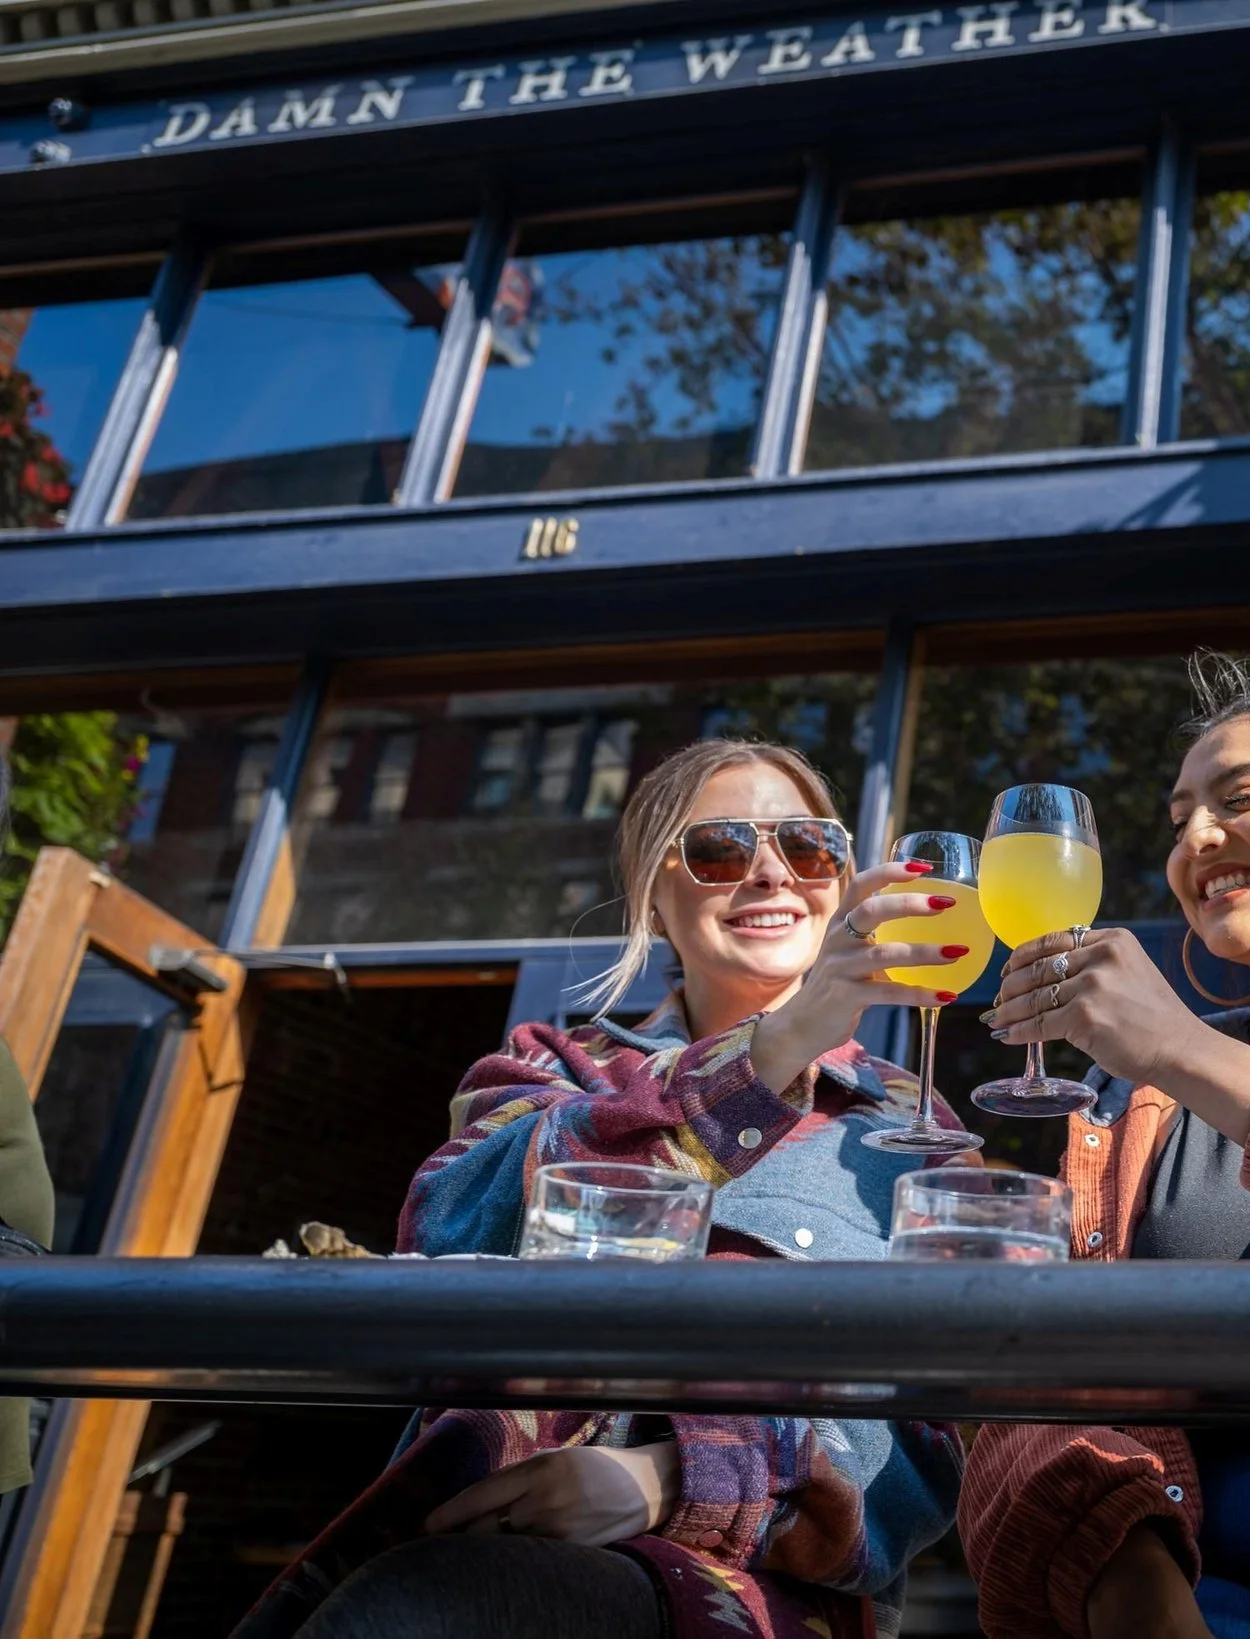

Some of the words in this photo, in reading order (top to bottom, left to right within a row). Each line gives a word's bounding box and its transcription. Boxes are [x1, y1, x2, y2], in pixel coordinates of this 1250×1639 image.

[152, 76, 415, 147] DAMN
[453, 49, 635, 110] THE
[680, 0, 1157, 83] WEATHER
[526, 516, 579, 558] 116
